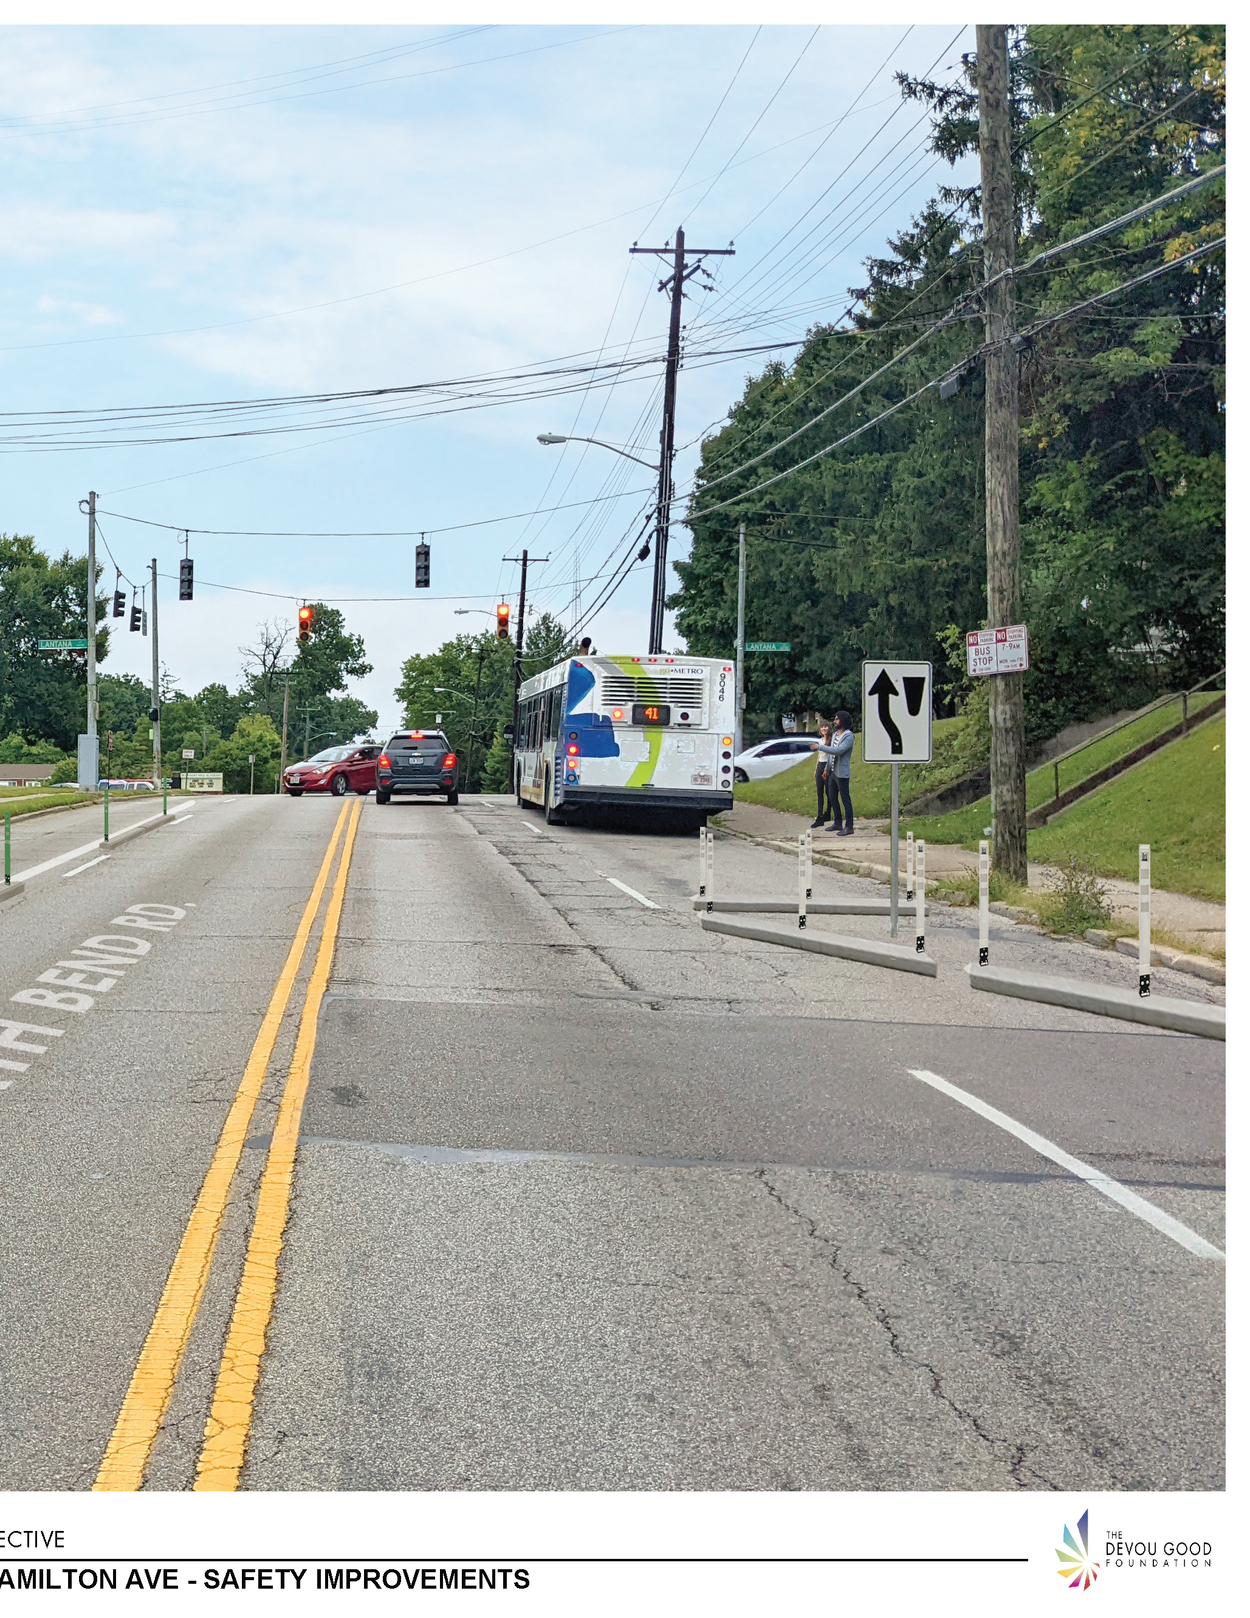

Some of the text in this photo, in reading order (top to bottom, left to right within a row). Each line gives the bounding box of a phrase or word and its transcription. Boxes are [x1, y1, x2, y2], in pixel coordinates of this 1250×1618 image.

[968, 635, 977, 644] NO
[996, 631, 1006, 640] NO
[40, 640, 73, 648] LANTANA
[745, 642, 777, 650] LANTANA
[974, 646, 991, 656] BUS
[972, 656, 993, 667] STOP
[718, 673, 726, 702] 9046
[645, 707, 659, 720] 41
[8, 934, 152, 1014] BEND
[109, 902, 197, 932] RD.
